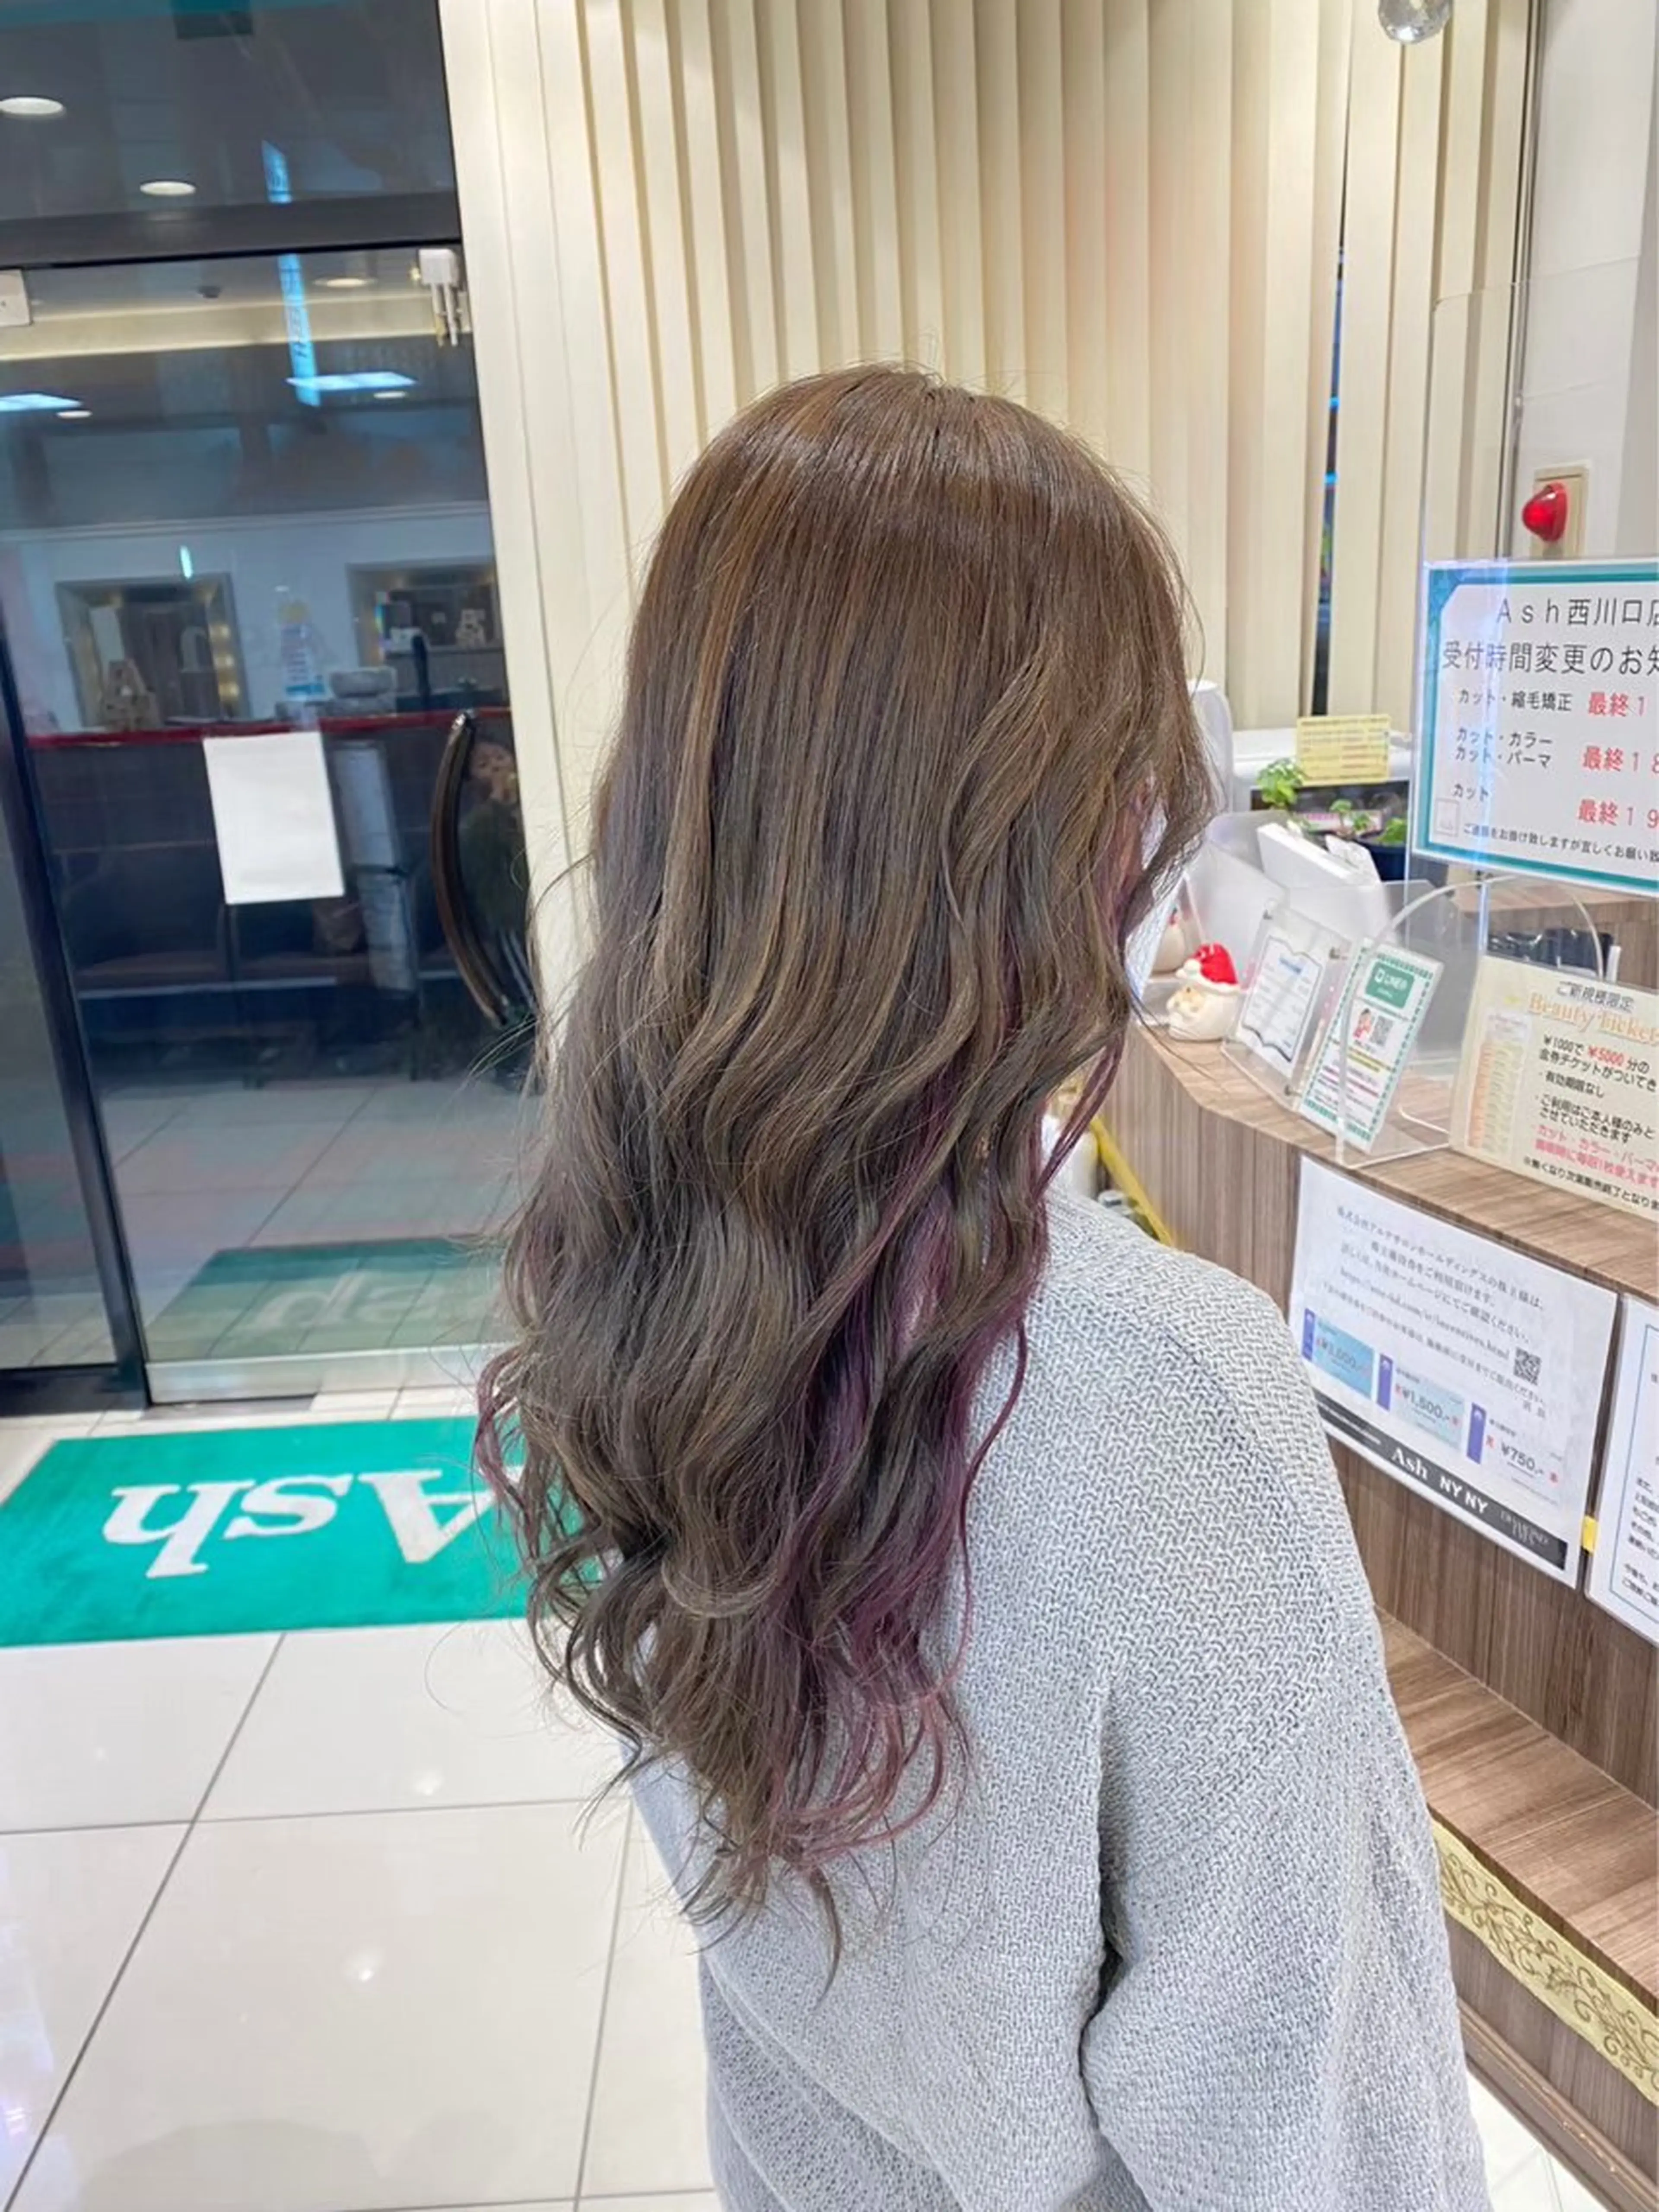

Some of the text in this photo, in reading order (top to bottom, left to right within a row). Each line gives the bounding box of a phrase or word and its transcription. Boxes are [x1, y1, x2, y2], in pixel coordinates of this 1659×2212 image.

[1453, 783, 1489, 801] カット
[1391, 1448, 1489, 1515] Ash NY NY
[102, 1465, 525, 1579] Ash
